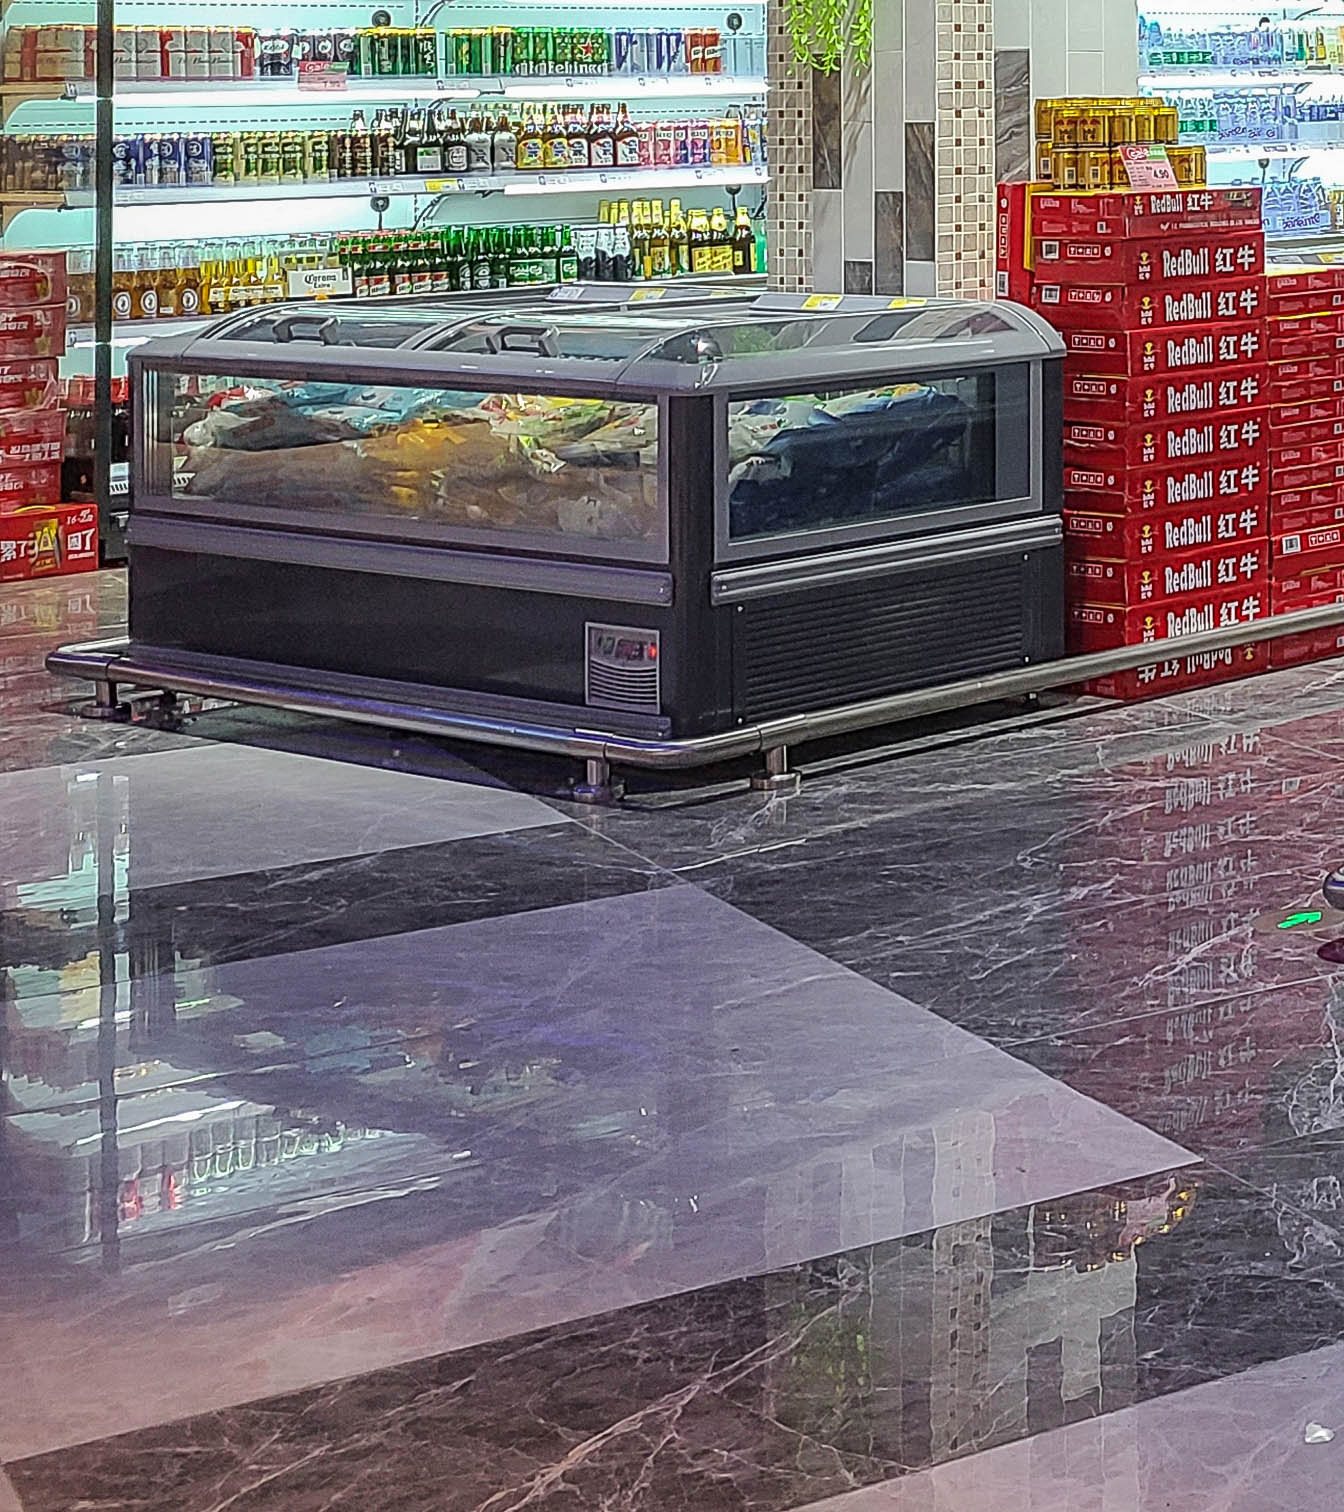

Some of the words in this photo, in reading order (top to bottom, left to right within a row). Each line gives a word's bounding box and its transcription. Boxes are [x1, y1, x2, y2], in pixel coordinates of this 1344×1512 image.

[1163, 248, 1209, 278] RedBull
[1215, 245, 1256, 272] 红牛
[1165, 292, 1211, 322] RedBull
[1218, 289, 1258, 316] 红牛
[1167, 335, 1213, 368] RedBull
[1219, 333, 1259, 360] 红牛
[1167, 381, 1213, 414] RedBull
[1218, 377, 1259, 406] 红牛
[1167, 425, 1213, 458] RedBull
[1219, 420, 1260, 450] 红牛
[1167, 471, 1213, 504] RedBull
[1219, 465, 1259, 495] 红牛
[1165, 515, 1211, 548] RedBull
[1217, 509, 1257, 538] 红牛
[1165, 559, 1211, 594] RedBull
[1217, 553, 1258, 584] 红牛
[1167, 604, 1213, 639] RedBull
